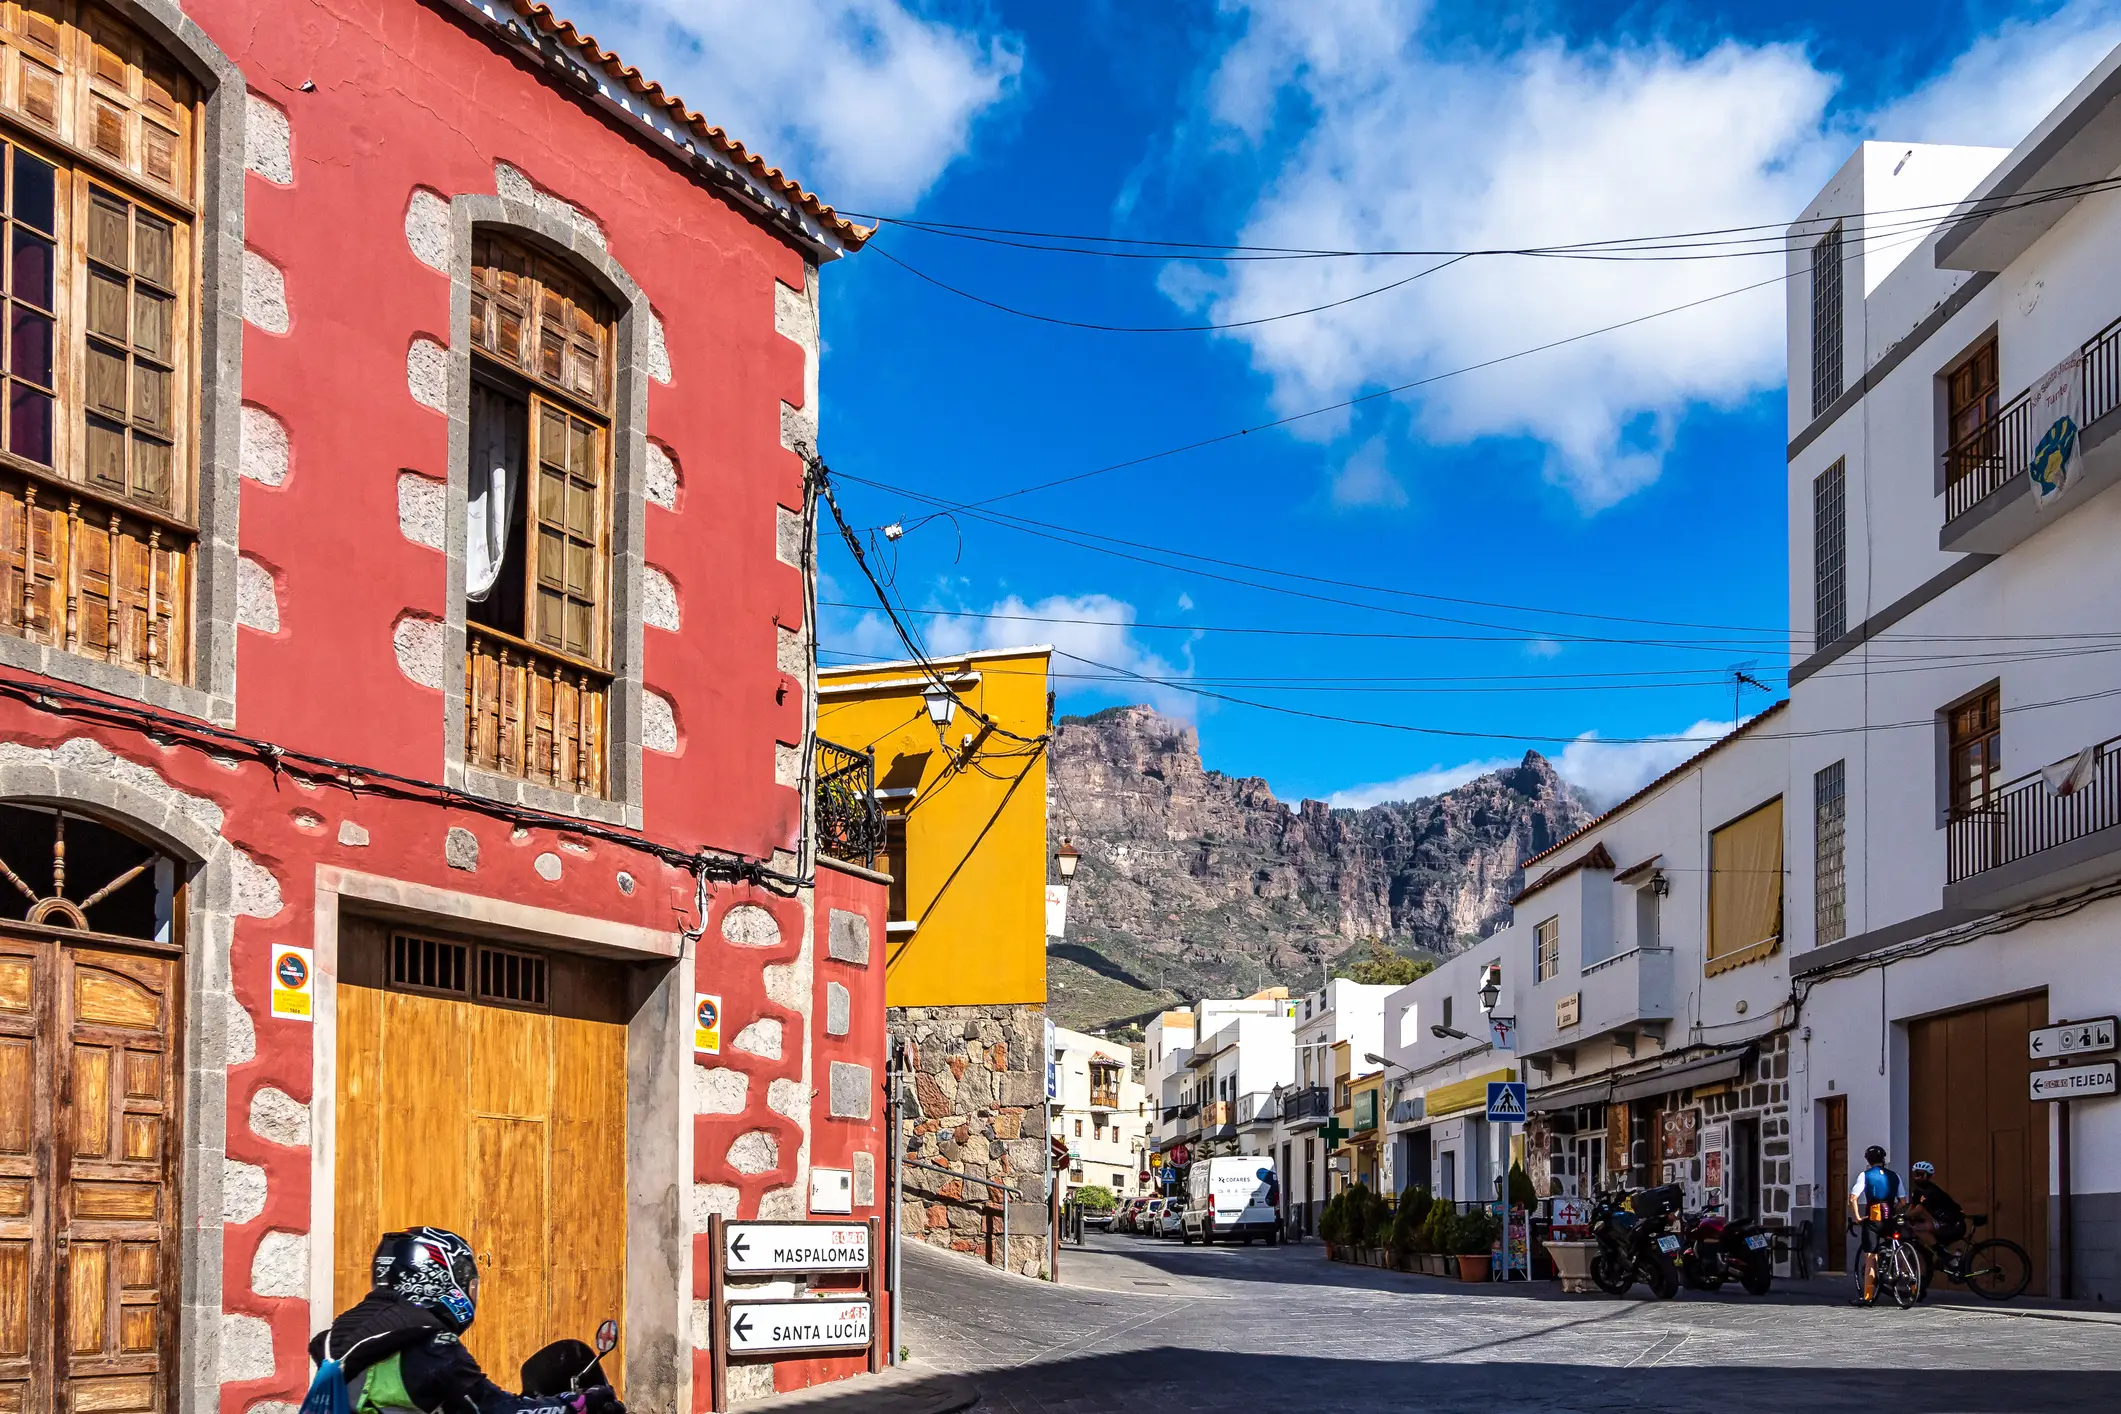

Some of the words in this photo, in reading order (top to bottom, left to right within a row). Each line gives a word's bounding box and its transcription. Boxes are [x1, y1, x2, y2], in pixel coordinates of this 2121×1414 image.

[2069, 1073, 2113, 1087] TEJEDA
[774, 1248, 865, 1262] MASPALOMAS
[773, 1325, 820, 1341] SANTA
[826, 1320, 867, 1339] LUCÍA
